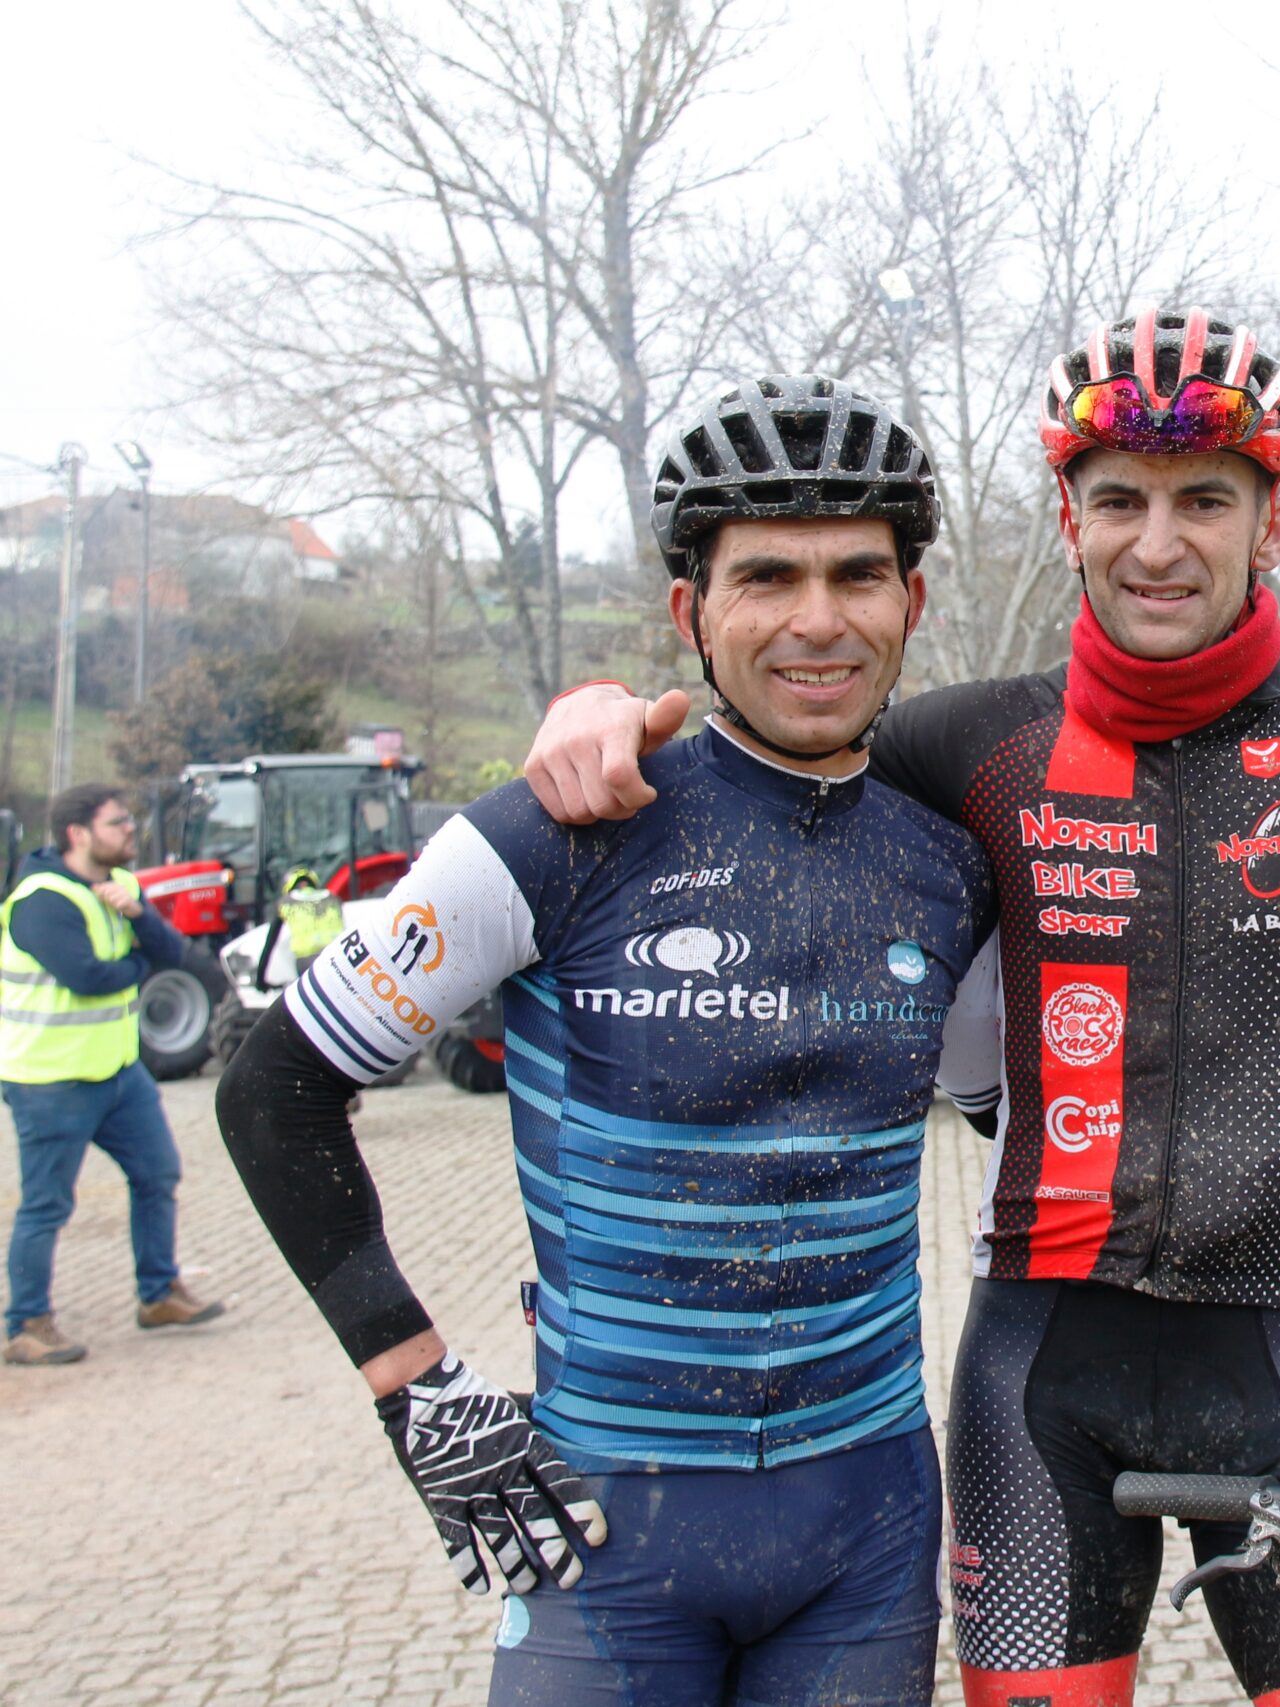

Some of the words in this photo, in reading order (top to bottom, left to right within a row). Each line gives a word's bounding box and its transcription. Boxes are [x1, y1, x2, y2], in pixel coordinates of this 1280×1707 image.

[1032, 861, 1142, 899] BIKE
[1038, 905, 1131, 937] SPORT
[574, 978, 790, 1021] marietel
[376, 1015, 412, 1046] Alimentar
